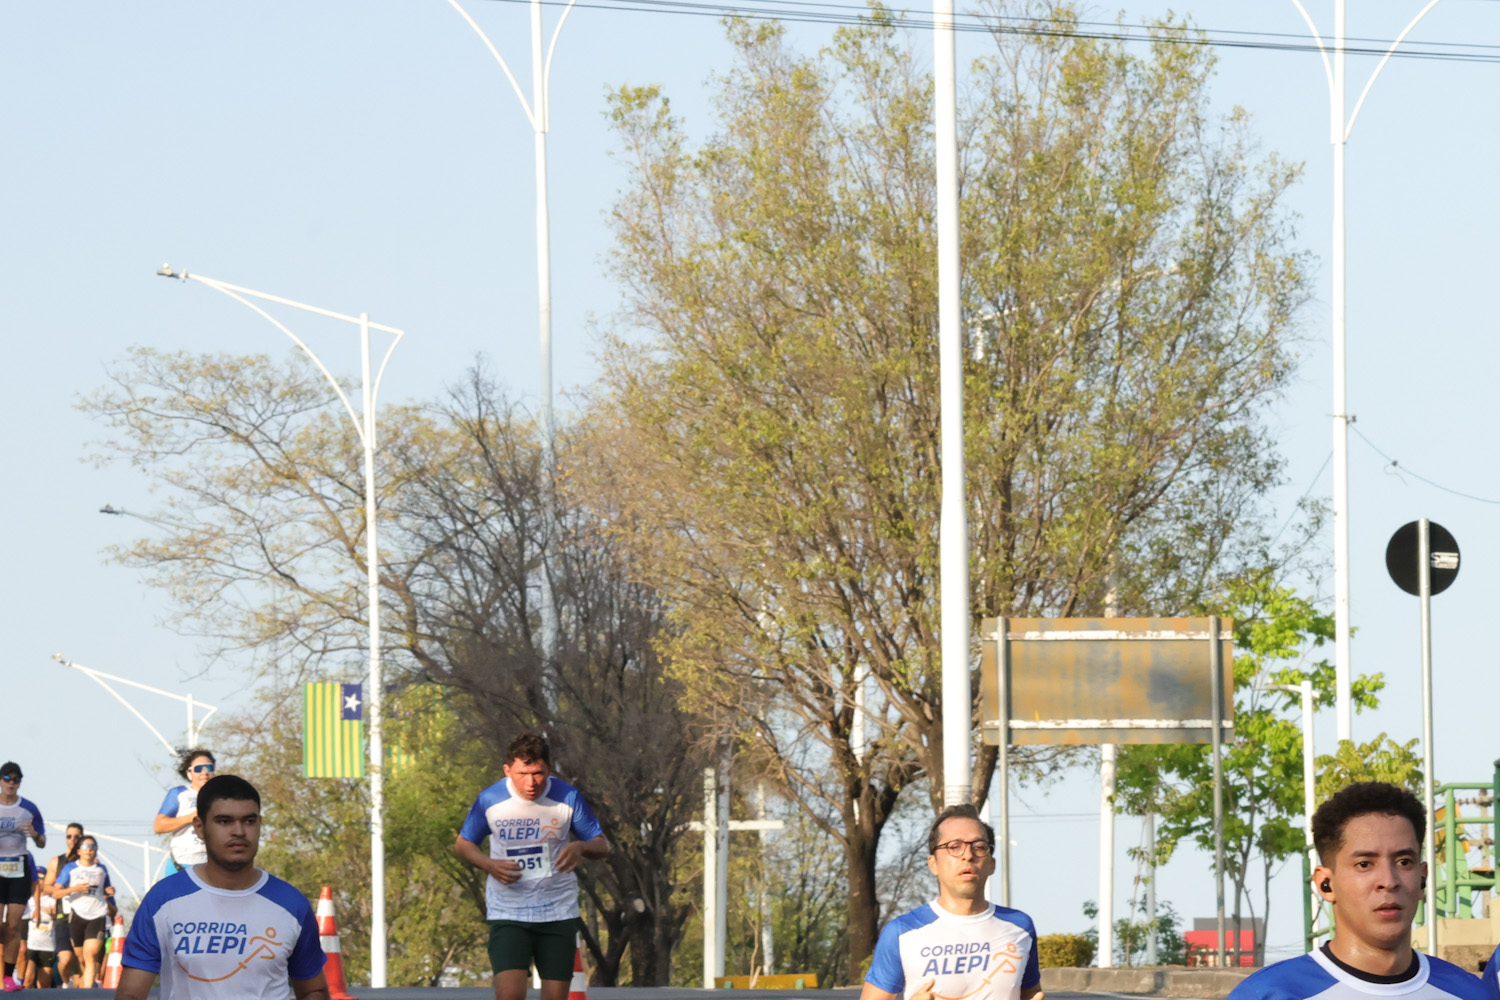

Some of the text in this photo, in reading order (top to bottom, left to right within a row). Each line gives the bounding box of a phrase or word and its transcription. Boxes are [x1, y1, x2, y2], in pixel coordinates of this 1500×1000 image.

[495, 818, 540, 828] CORRIDA
[500, 827, 540, 840] ALEPI
[173, 922, 247, 935] CORRIDA
[175, 936, 246, 955] ALEPI
[921, 942, 991, 958] CORRIDA
[923, 954, 990, 977] ALEPI
